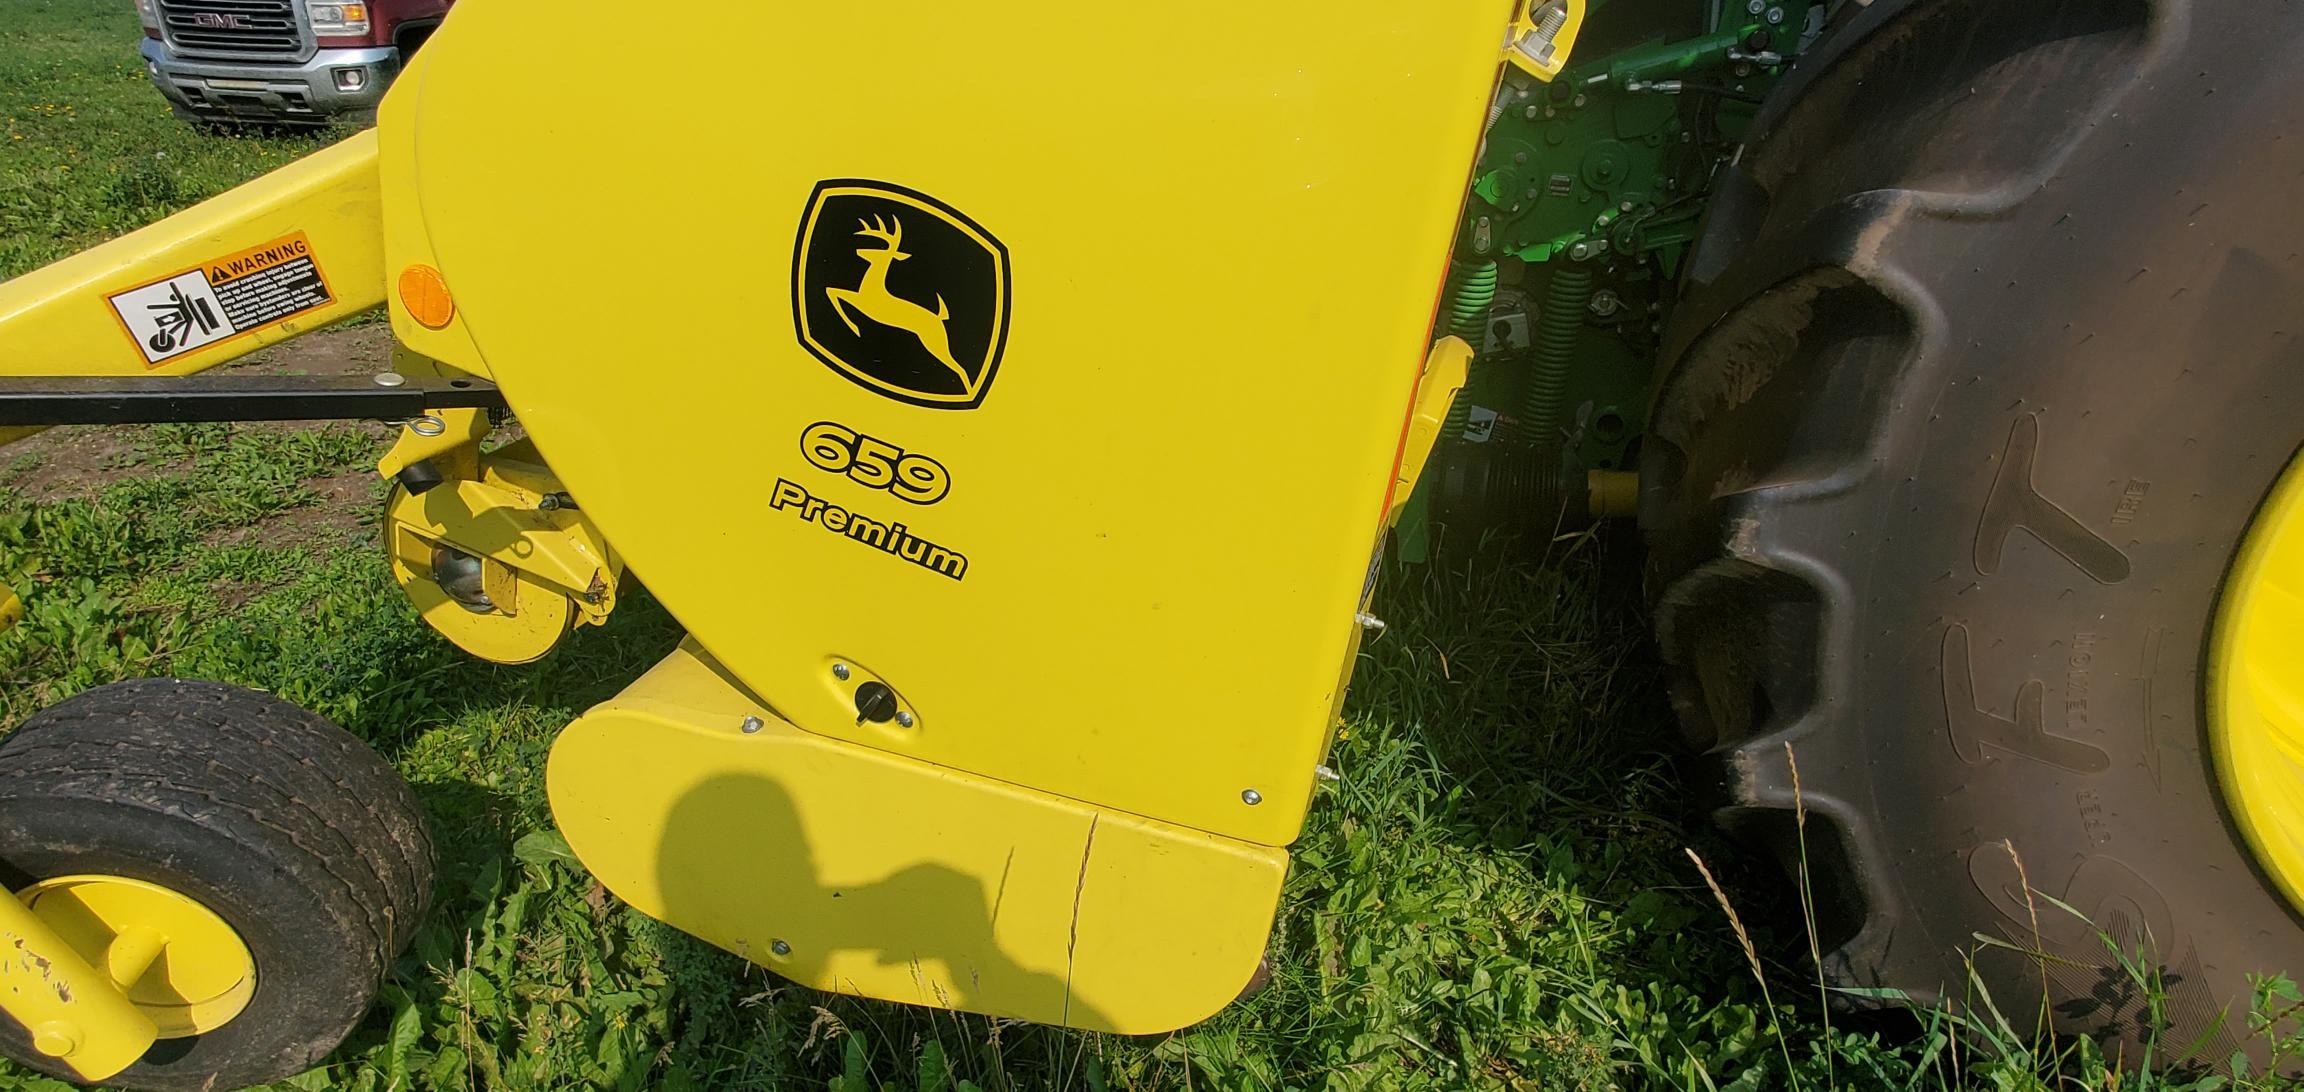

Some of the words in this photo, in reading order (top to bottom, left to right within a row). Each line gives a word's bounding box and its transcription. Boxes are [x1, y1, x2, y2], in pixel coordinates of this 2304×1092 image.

[193, 13, 253, 29] GMC
[228, 240, 306, 275] WARNING
[800, 421, 951, 505] 659
[769, 478, 968, 581] Premium
